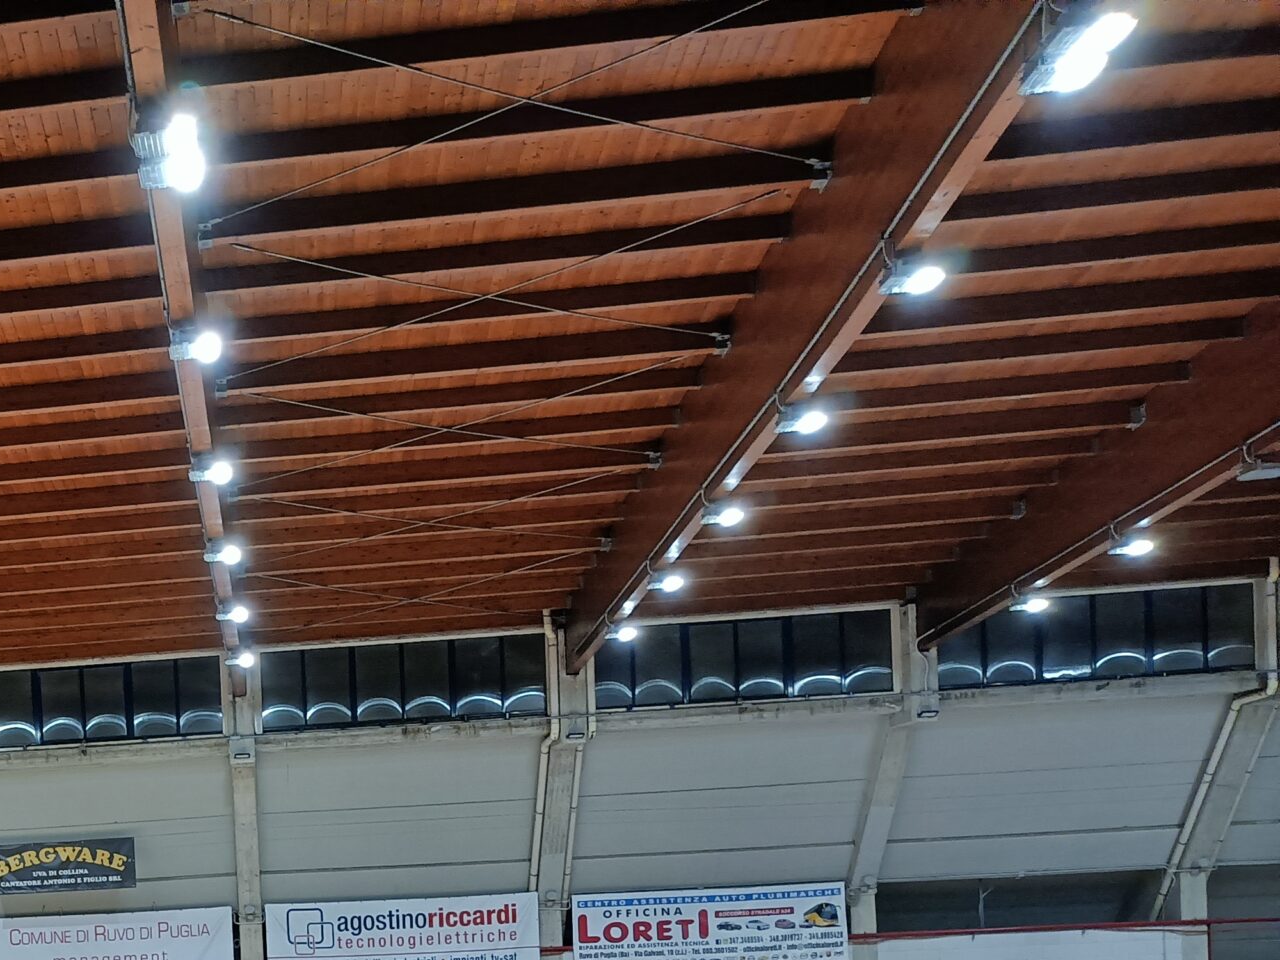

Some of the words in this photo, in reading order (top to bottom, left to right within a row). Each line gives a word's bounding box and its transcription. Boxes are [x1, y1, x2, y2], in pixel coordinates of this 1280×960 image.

[632, 896, 708, 904] ASSISTENZA
[752, 889, 840, 900] PLURIMARCHE
[337, 904, 517, 936] agostinoriccardi
[603, 907, 682, 919] OFFICINA
[10, 929, 71, 946] COMUNE
[77, 930, 89, 943] DI
[95, 925, 135, 942] RUVO
[140, 926, 152, 939] DI
[158, 921, 210, 938] PUGLIA
[578, 909, 709, 943] LORETI
[337, 929, 517, 950] tecnologielettriche
